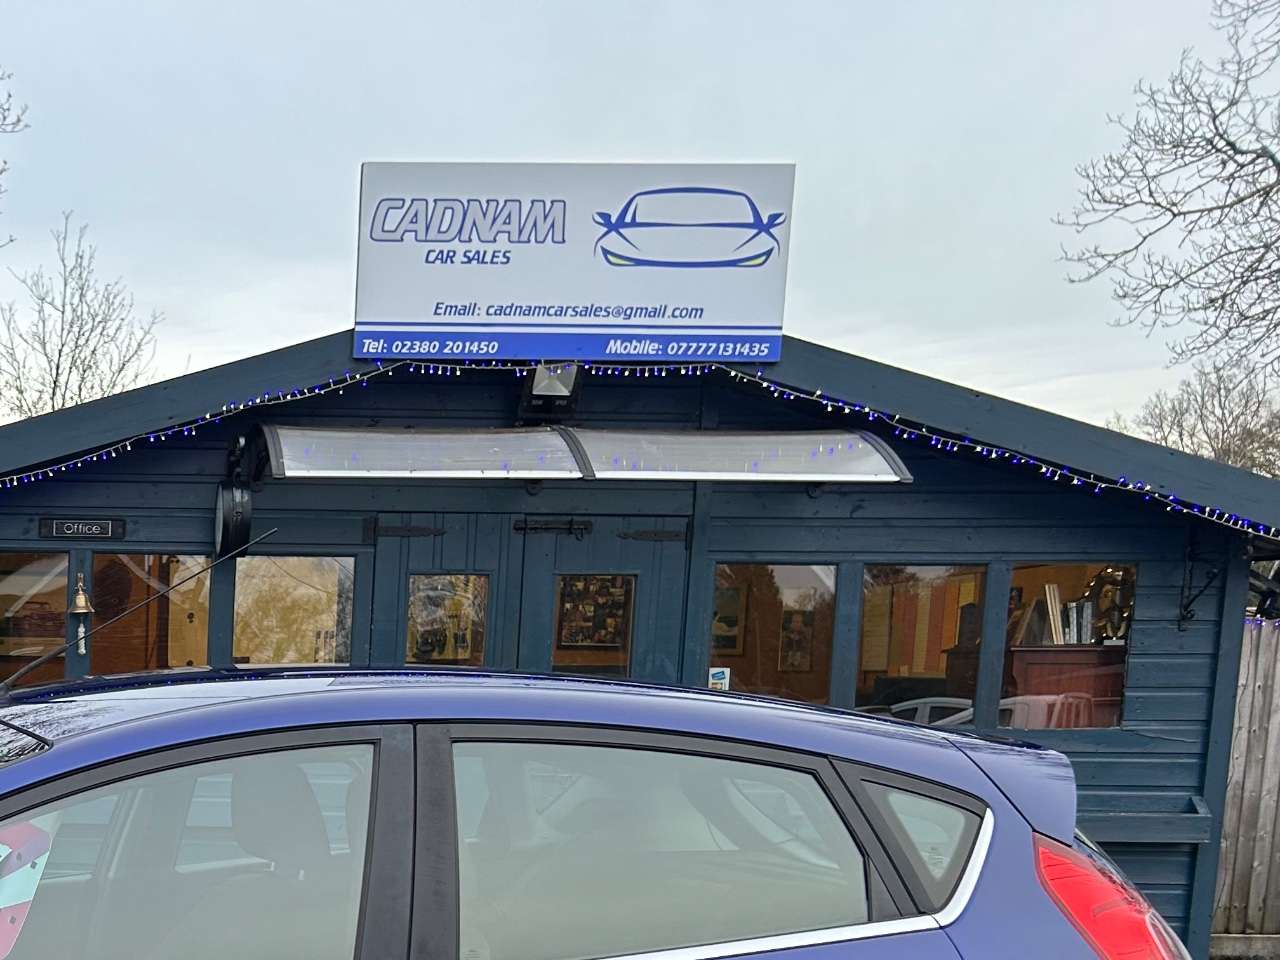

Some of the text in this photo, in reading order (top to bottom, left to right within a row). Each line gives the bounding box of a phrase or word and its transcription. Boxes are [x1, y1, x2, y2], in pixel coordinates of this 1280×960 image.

[370, 197, 567, 244] CADNAM
[424, 249, 512, 265] CAR SALES
[432, 301, 705, 320] Email: cadnamcarsales@gmail.com
[361, 339, 770, 356] Tel: 02380 201450 Mobile: 07777131435
[63, 522, 101, 534] Office
